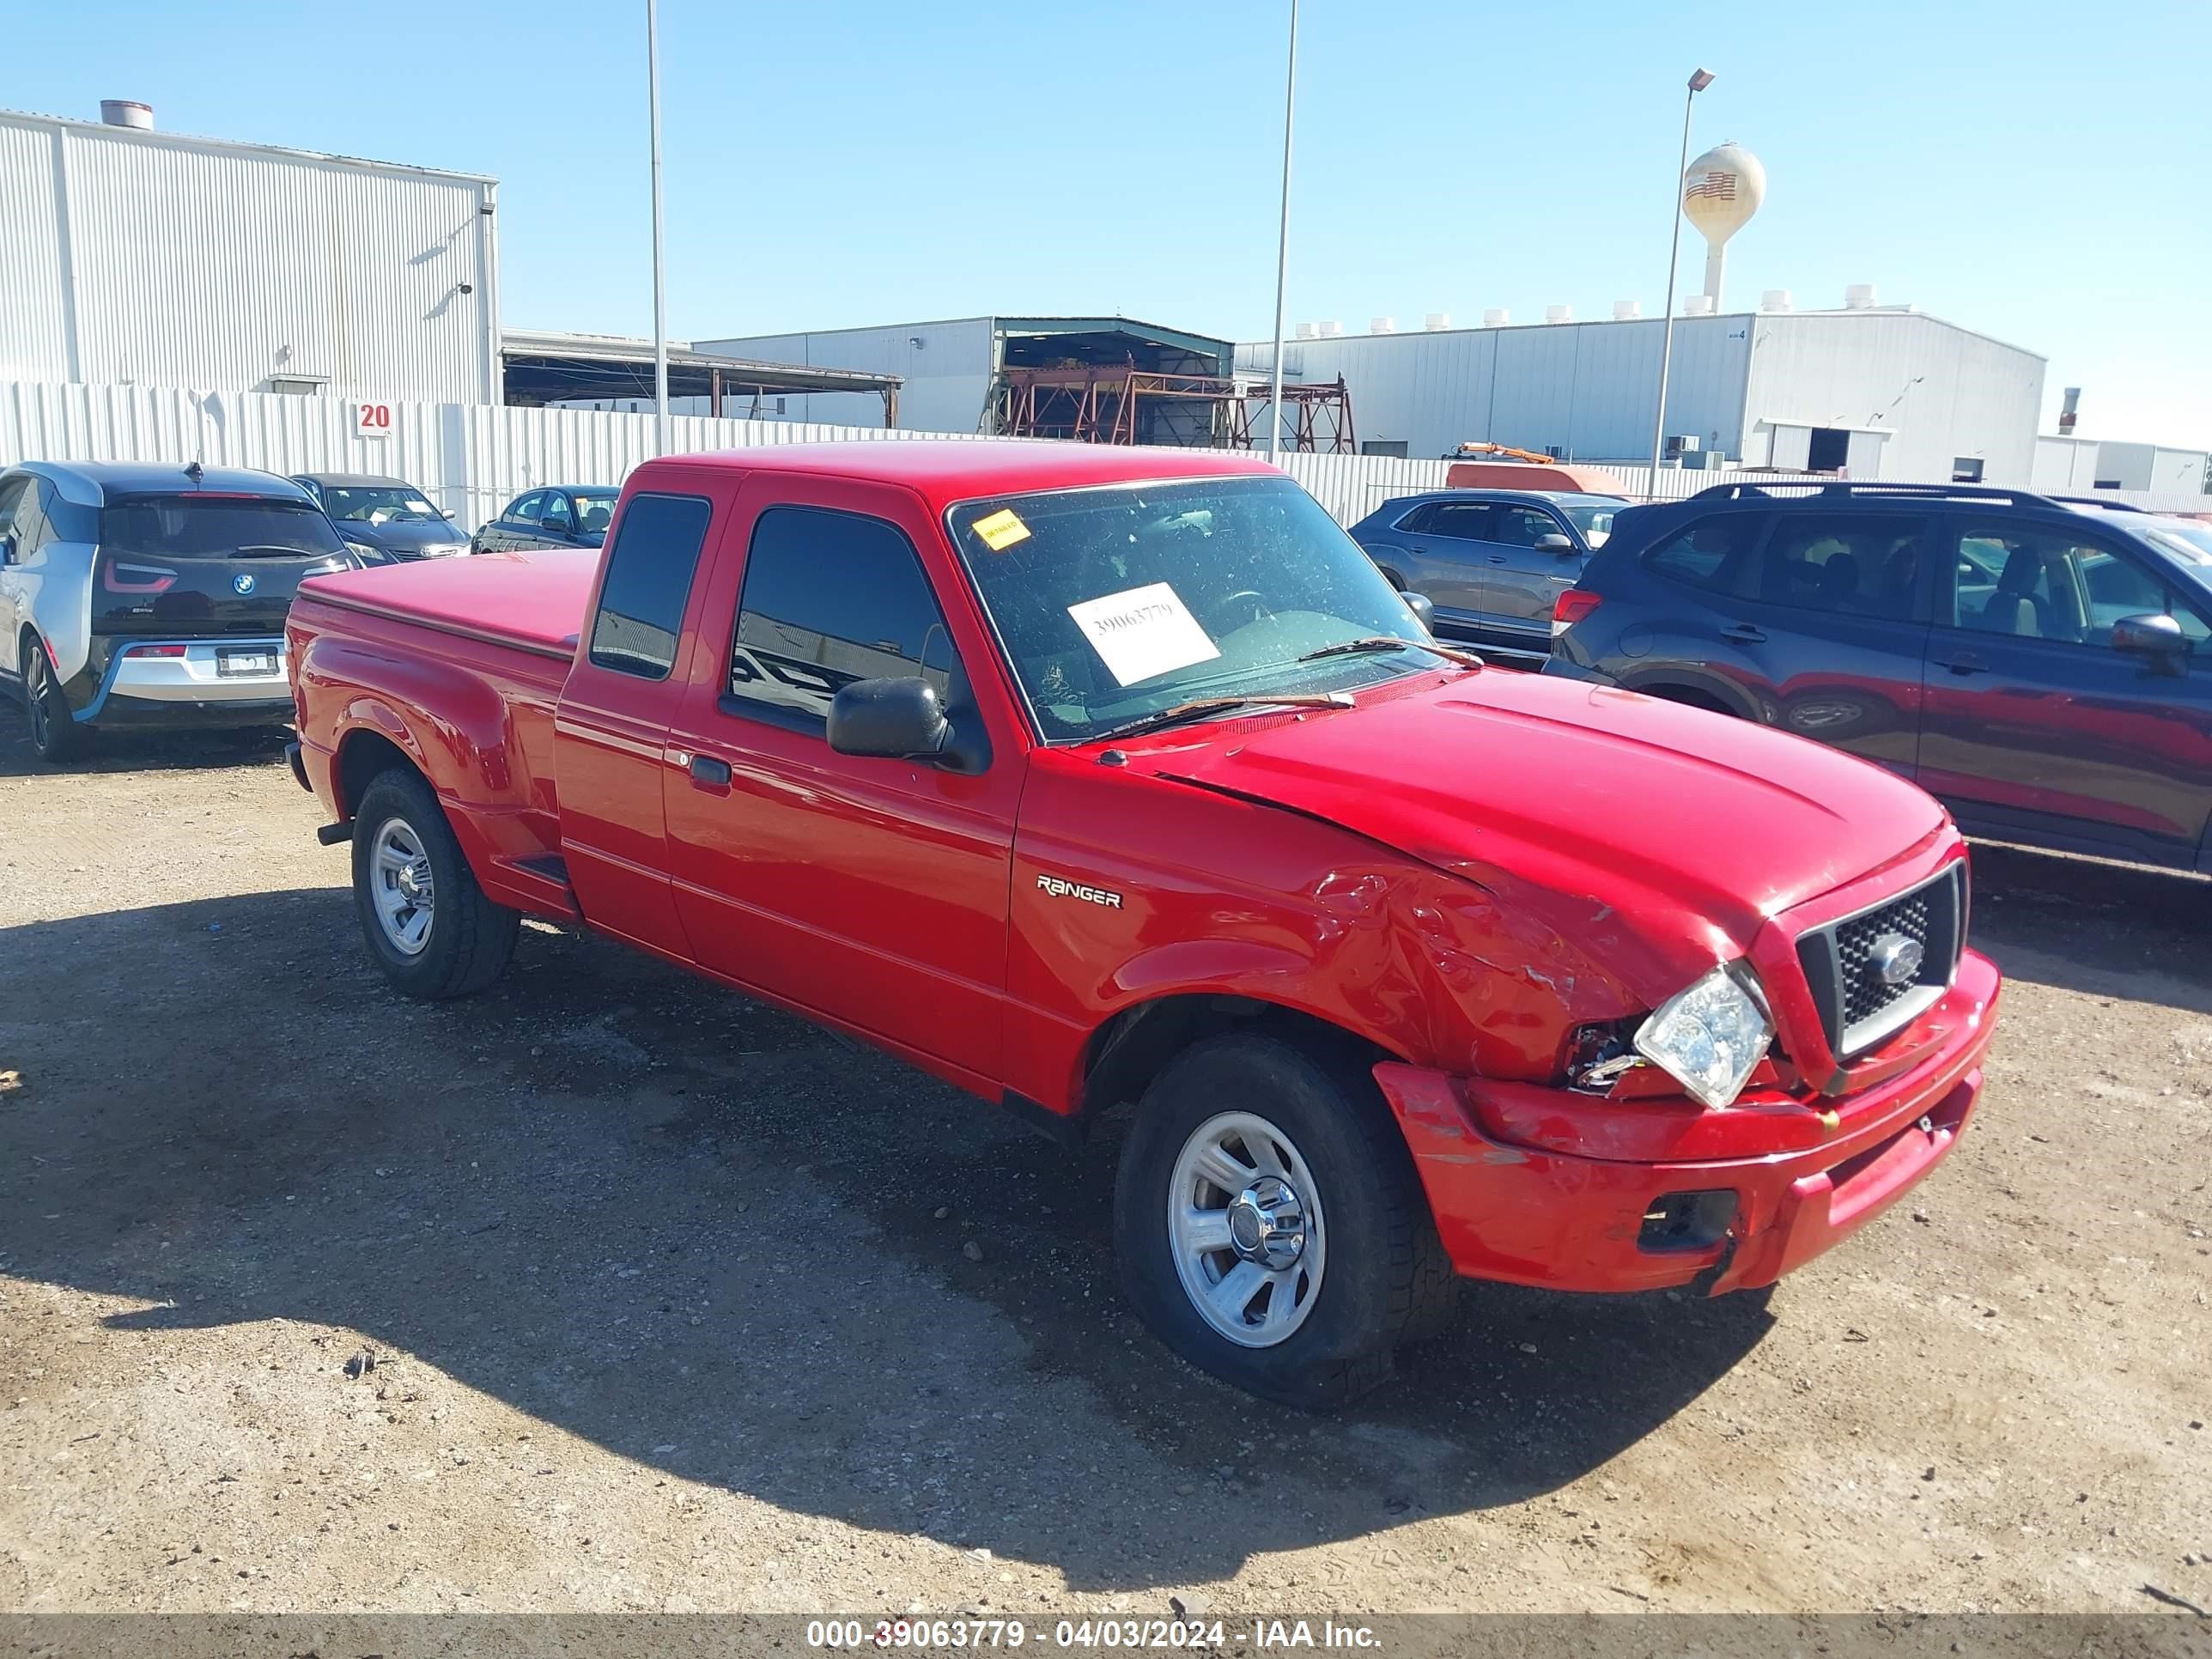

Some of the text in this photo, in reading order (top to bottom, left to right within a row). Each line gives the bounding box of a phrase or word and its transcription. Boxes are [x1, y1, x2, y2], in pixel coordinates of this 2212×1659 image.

[1739, 329, 1746, 339] 4
[360, 404, 390, 428] 20
[985, 520, 1018, 539] DETAILED
[1093, 603, 1173, 636] 39063779
[1036, 873, 1122, 910] RANGER
